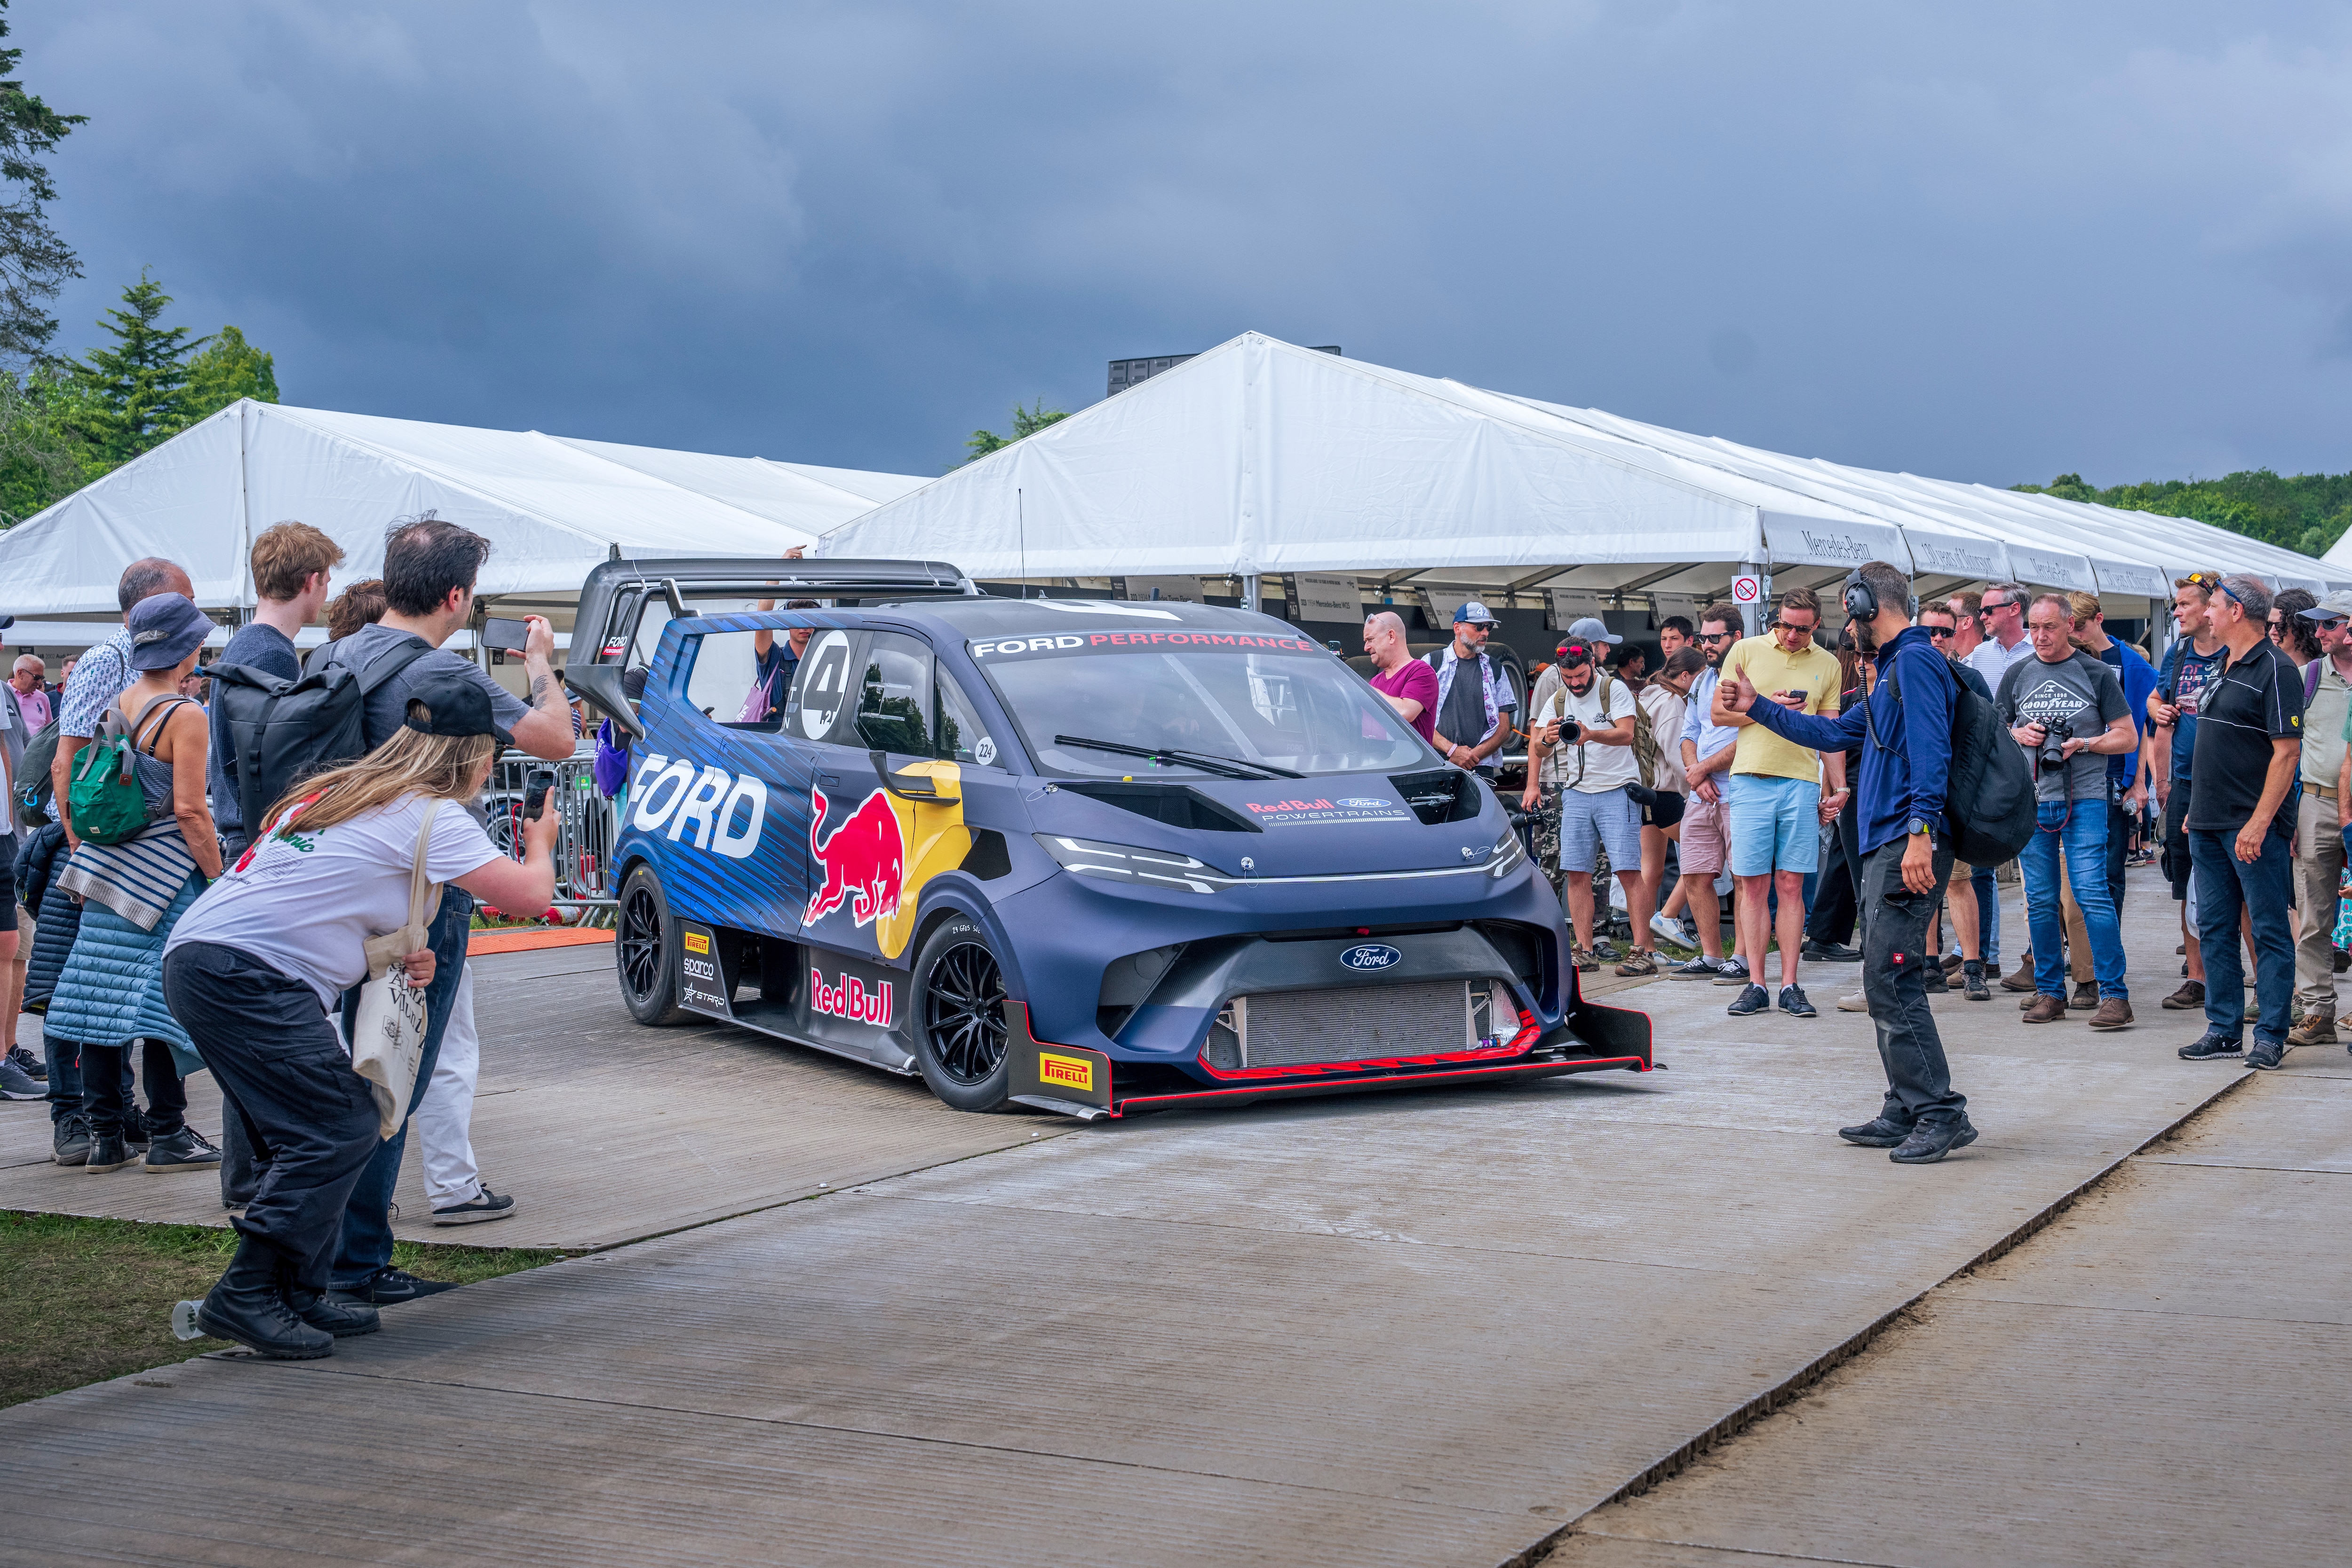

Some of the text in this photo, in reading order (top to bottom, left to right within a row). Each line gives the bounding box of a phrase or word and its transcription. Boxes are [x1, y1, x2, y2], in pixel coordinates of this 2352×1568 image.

[1801, 531, 1873, 560] Mercedes-Benz
[1922, 542, 1996, 577] 130 years of Motorsport
[2030, 558, 2074, 583] Mercedes-Benz
[1316, 600, 1341, 608] Mercedes-Benz
[607, 636, 628, 647] FORD
[974, 636, 1084, 657] FORD
[1090, 634, 1313, 651] PERFORMANCE
[978, 744, 993, 758] 224
[628, 753, 767, 859] FORD
[1246, 801, 1291, 813] Red
[1289, 799, 1335, 810] Bull
[1262, 810, 1405, 821] POWERTRAINS
[687, 936, 707, 950] PIRELLI
[1353, 948, 1389, 966] Ford
[684, 958, 714, 978] sparco
[697, 991, 725, 1008] STARD
[812, 970, 891, 1025] Red Bull
[1045, 1059, 1088, 1084] PIRELLI
